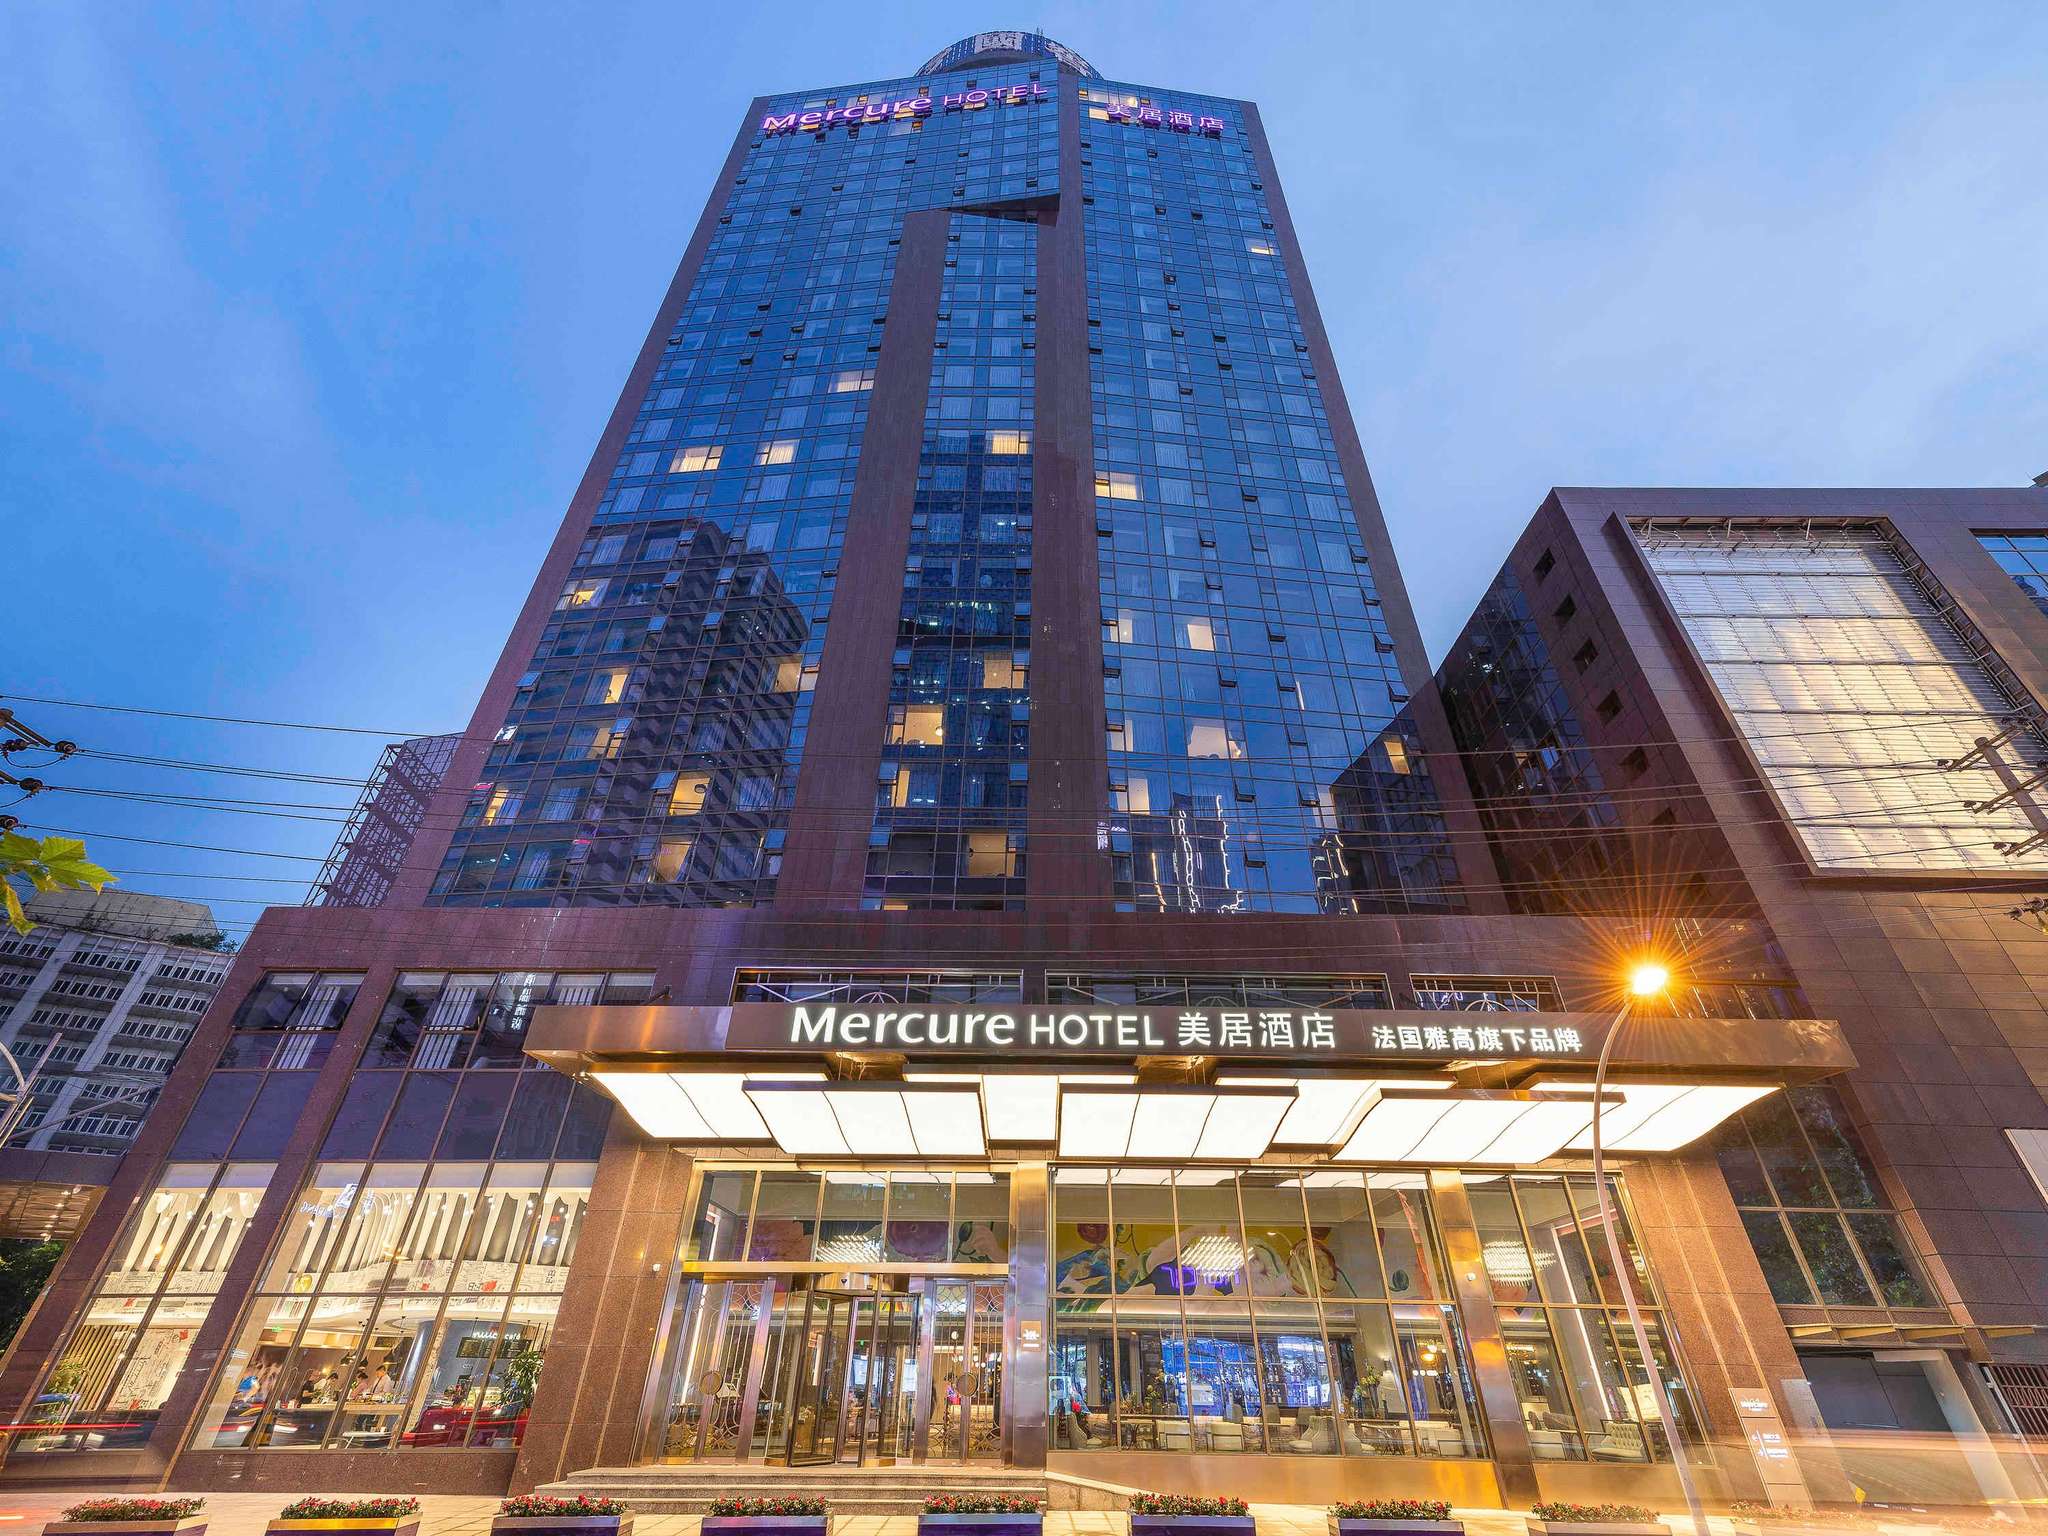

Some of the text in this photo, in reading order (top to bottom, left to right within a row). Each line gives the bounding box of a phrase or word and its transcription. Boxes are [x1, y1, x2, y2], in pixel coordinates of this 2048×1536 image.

[763, 83, 1048, 129] Mercure HOTEL
[1105, 103, 1224, 130] 美居酒店
[790, 1006, 1337, 1049] Mercure HOTEL 美居酒店
[1371, 1025, 1583, 1053] 法国雅高旗下品牌
